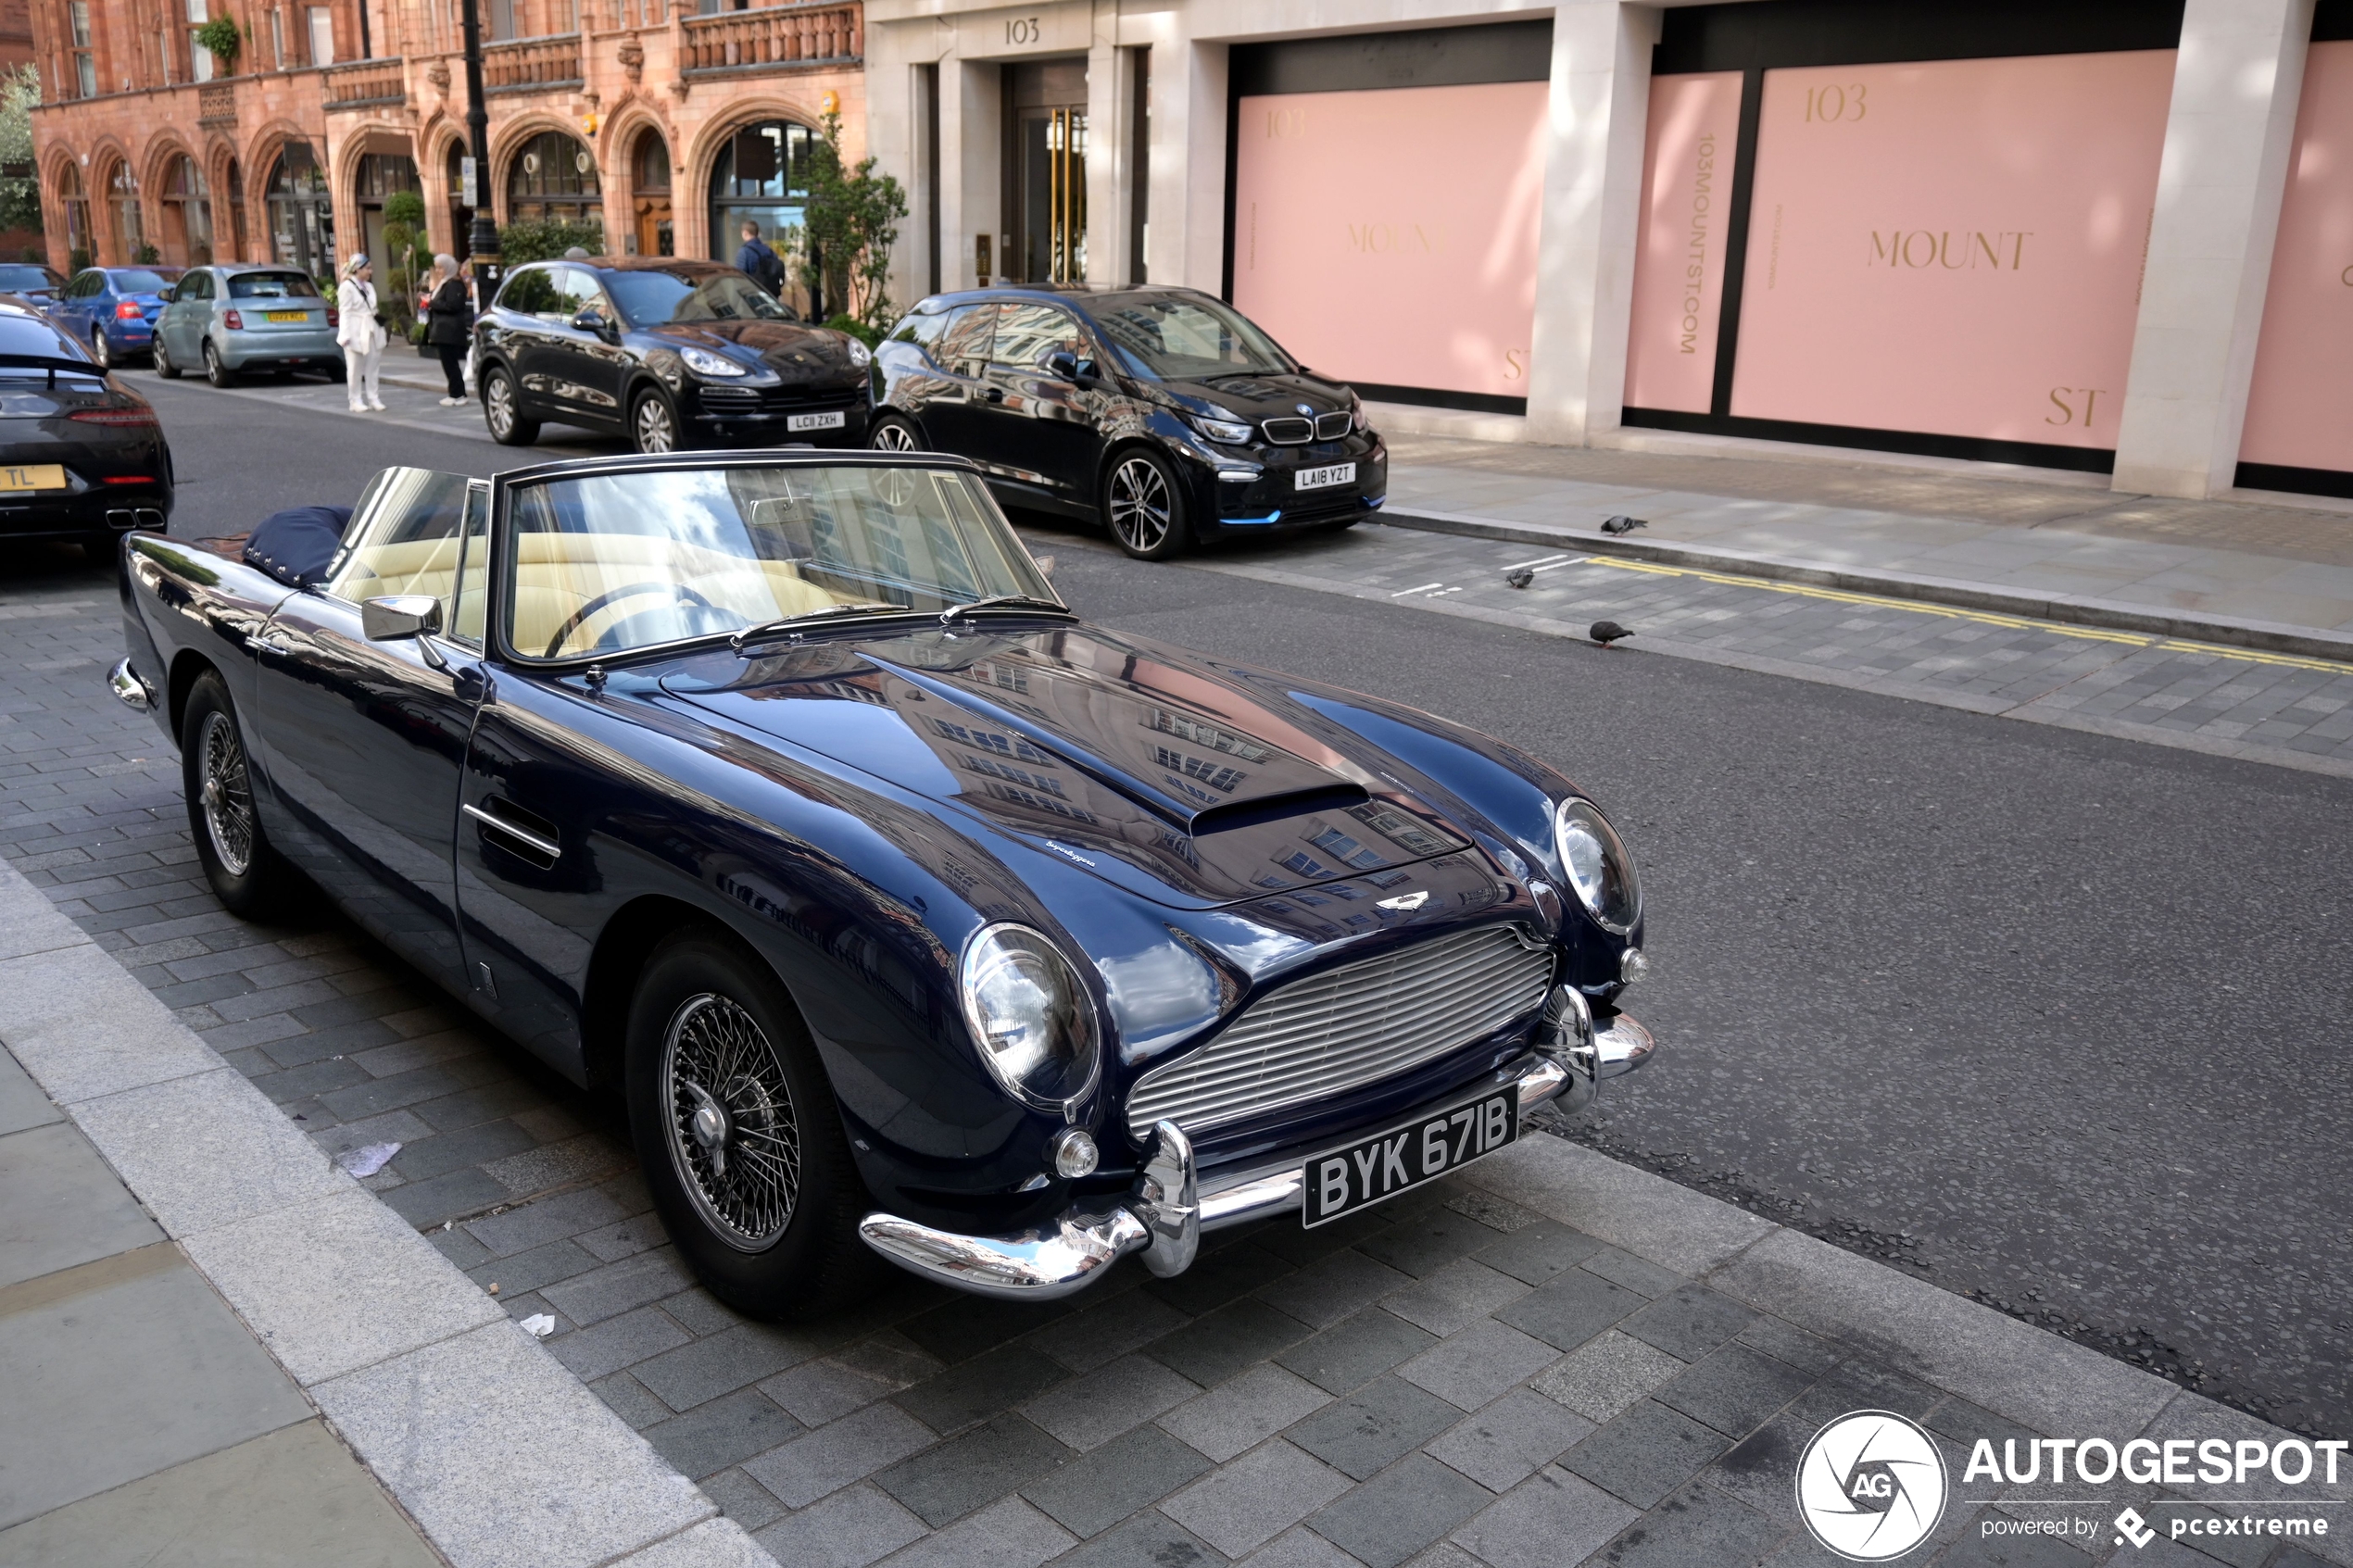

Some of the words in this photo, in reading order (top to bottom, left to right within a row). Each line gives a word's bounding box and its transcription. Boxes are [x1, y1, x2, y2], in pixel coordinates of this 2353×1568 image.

[1005, 18, 1039, 44] 103
[1805, 82, 1868, 122] 103
[1266, 107, 1306, 138] 103
[1680, 133, 1716, 355] 103MOUNTST.COM
[1868, 230, 2034, 270] MOUNT
[1504, 348, 1531, 381] S
[817, 414, 837, 426] ZXH
[2045, 386, 2107, 427] ST
[6, 468, 35, 486] TL
[1302, 470, 1327, 487] LA18
[1330, 466, 1350, 483] YZT
[1320, 1132, 1409, 1216] BYK
[1422, 1096, 1508, 1175] 671B
